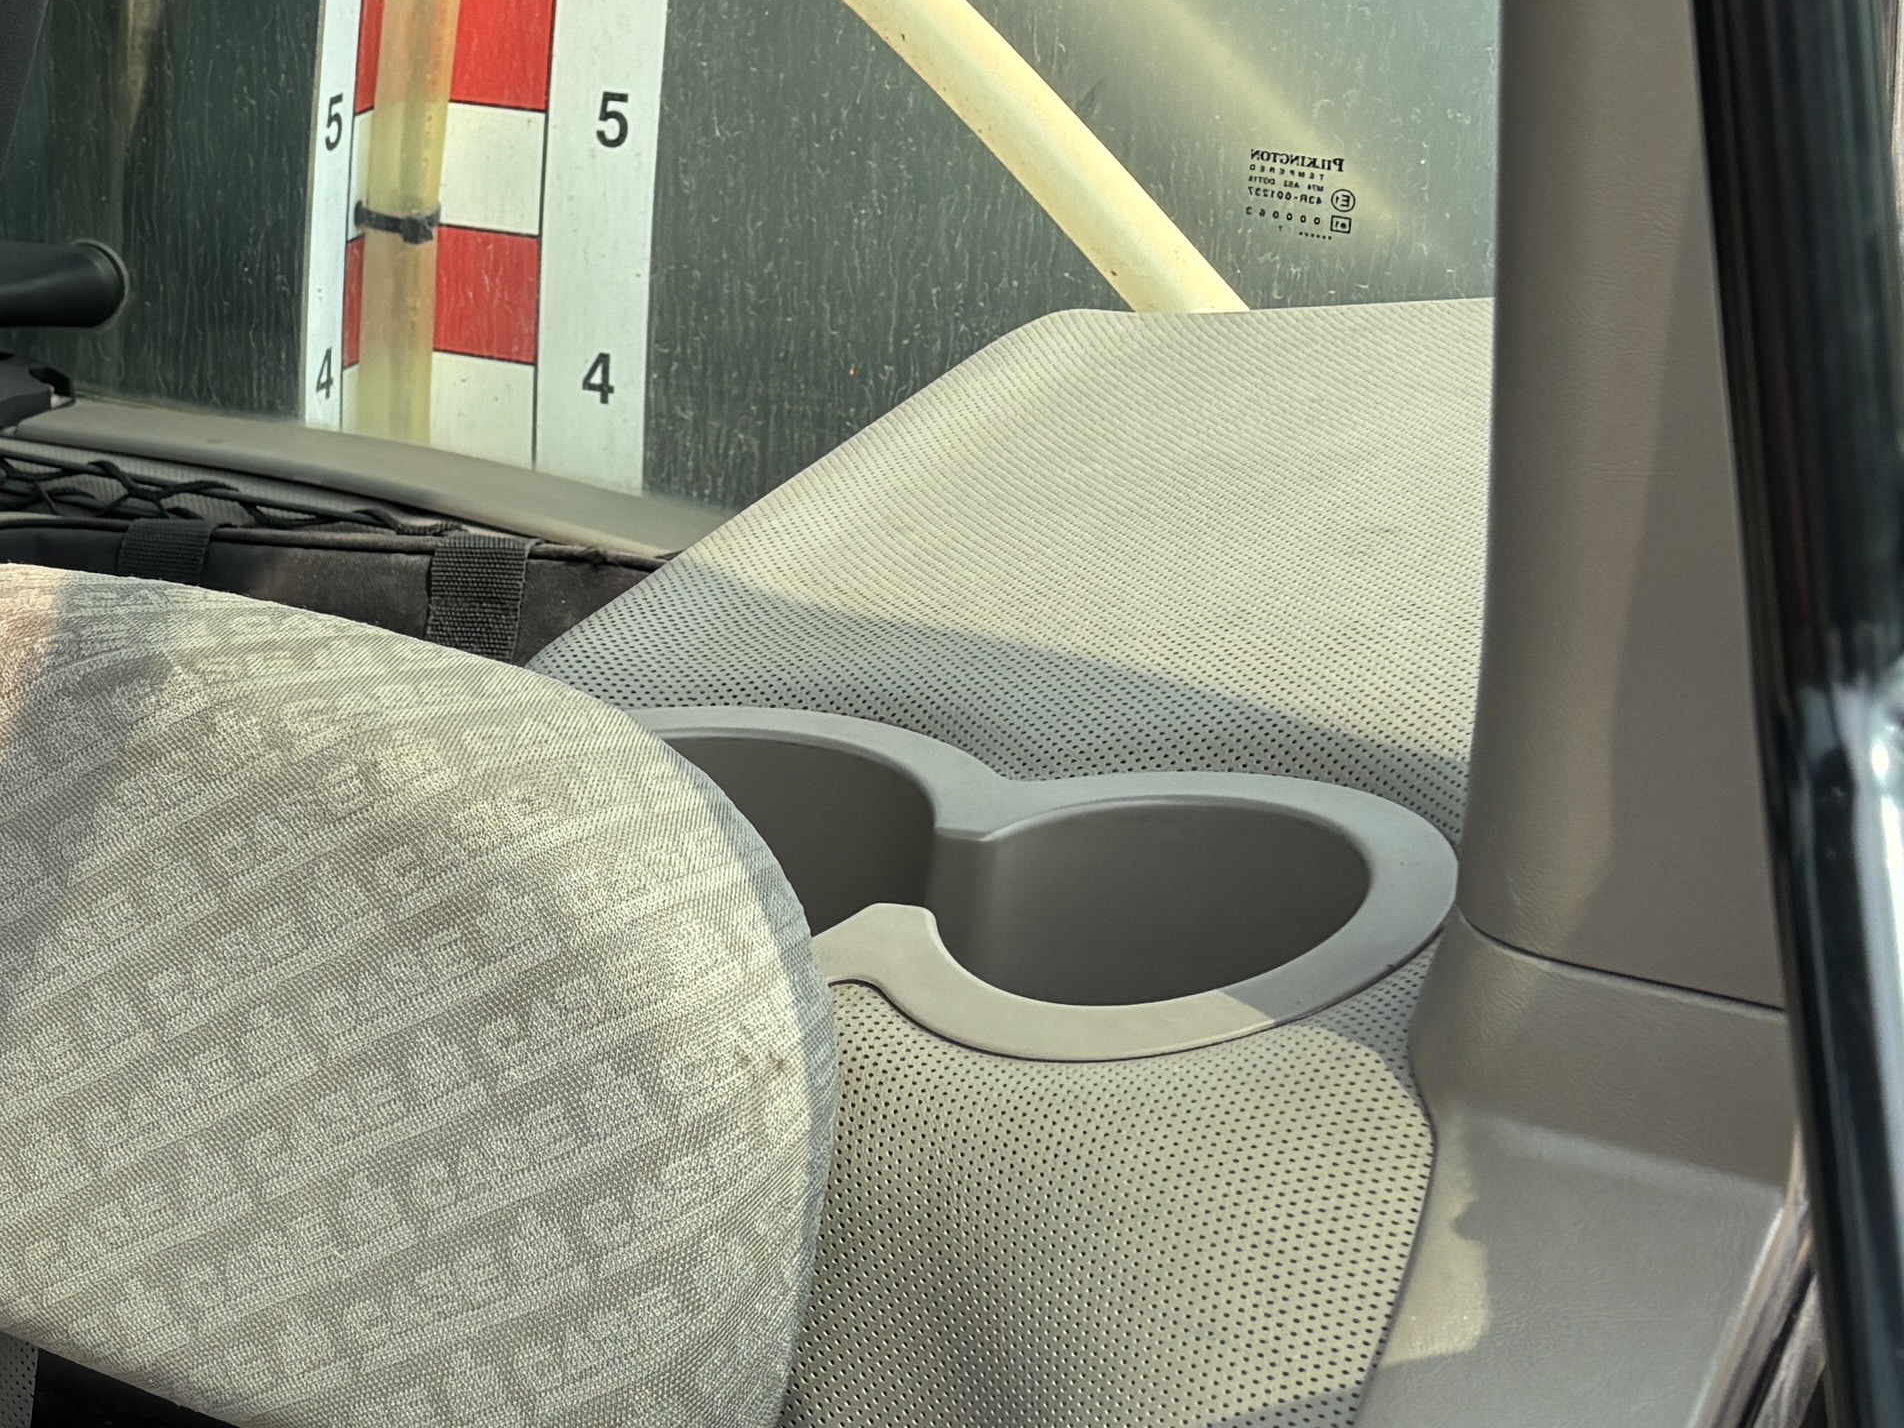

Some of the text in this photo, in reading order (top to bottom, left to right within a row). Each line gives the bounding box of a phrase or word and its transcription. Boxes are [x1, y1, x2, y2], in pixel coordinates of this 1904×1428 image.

[324, 92, 343, 152] 5
[596, 92, 630, 147] 5
[316, 347, 334, 400] 4
[582, 353, 615, 405] 4
[52, 749, 194, 852] CASE
[210, 761, 369, 869] CASE
[377, 782, 547, 892] CASE
[148, 903, 305, 1013] CASE
[309, 927, 476, 1033] CASE
[477, 957, 651, 1063] CASE
[86, 1044, 234, 1144] CASE
[242, 1071, 406, 1171] CASE
[410, 1105, 580, 1208] CASE
[582, 1122, 752, 1245] CASE
[182, 1209, 338, 1305] CASE
[346, 1246, 503, 1342] CASE
[514, 1283, 684, 1389] CASE
